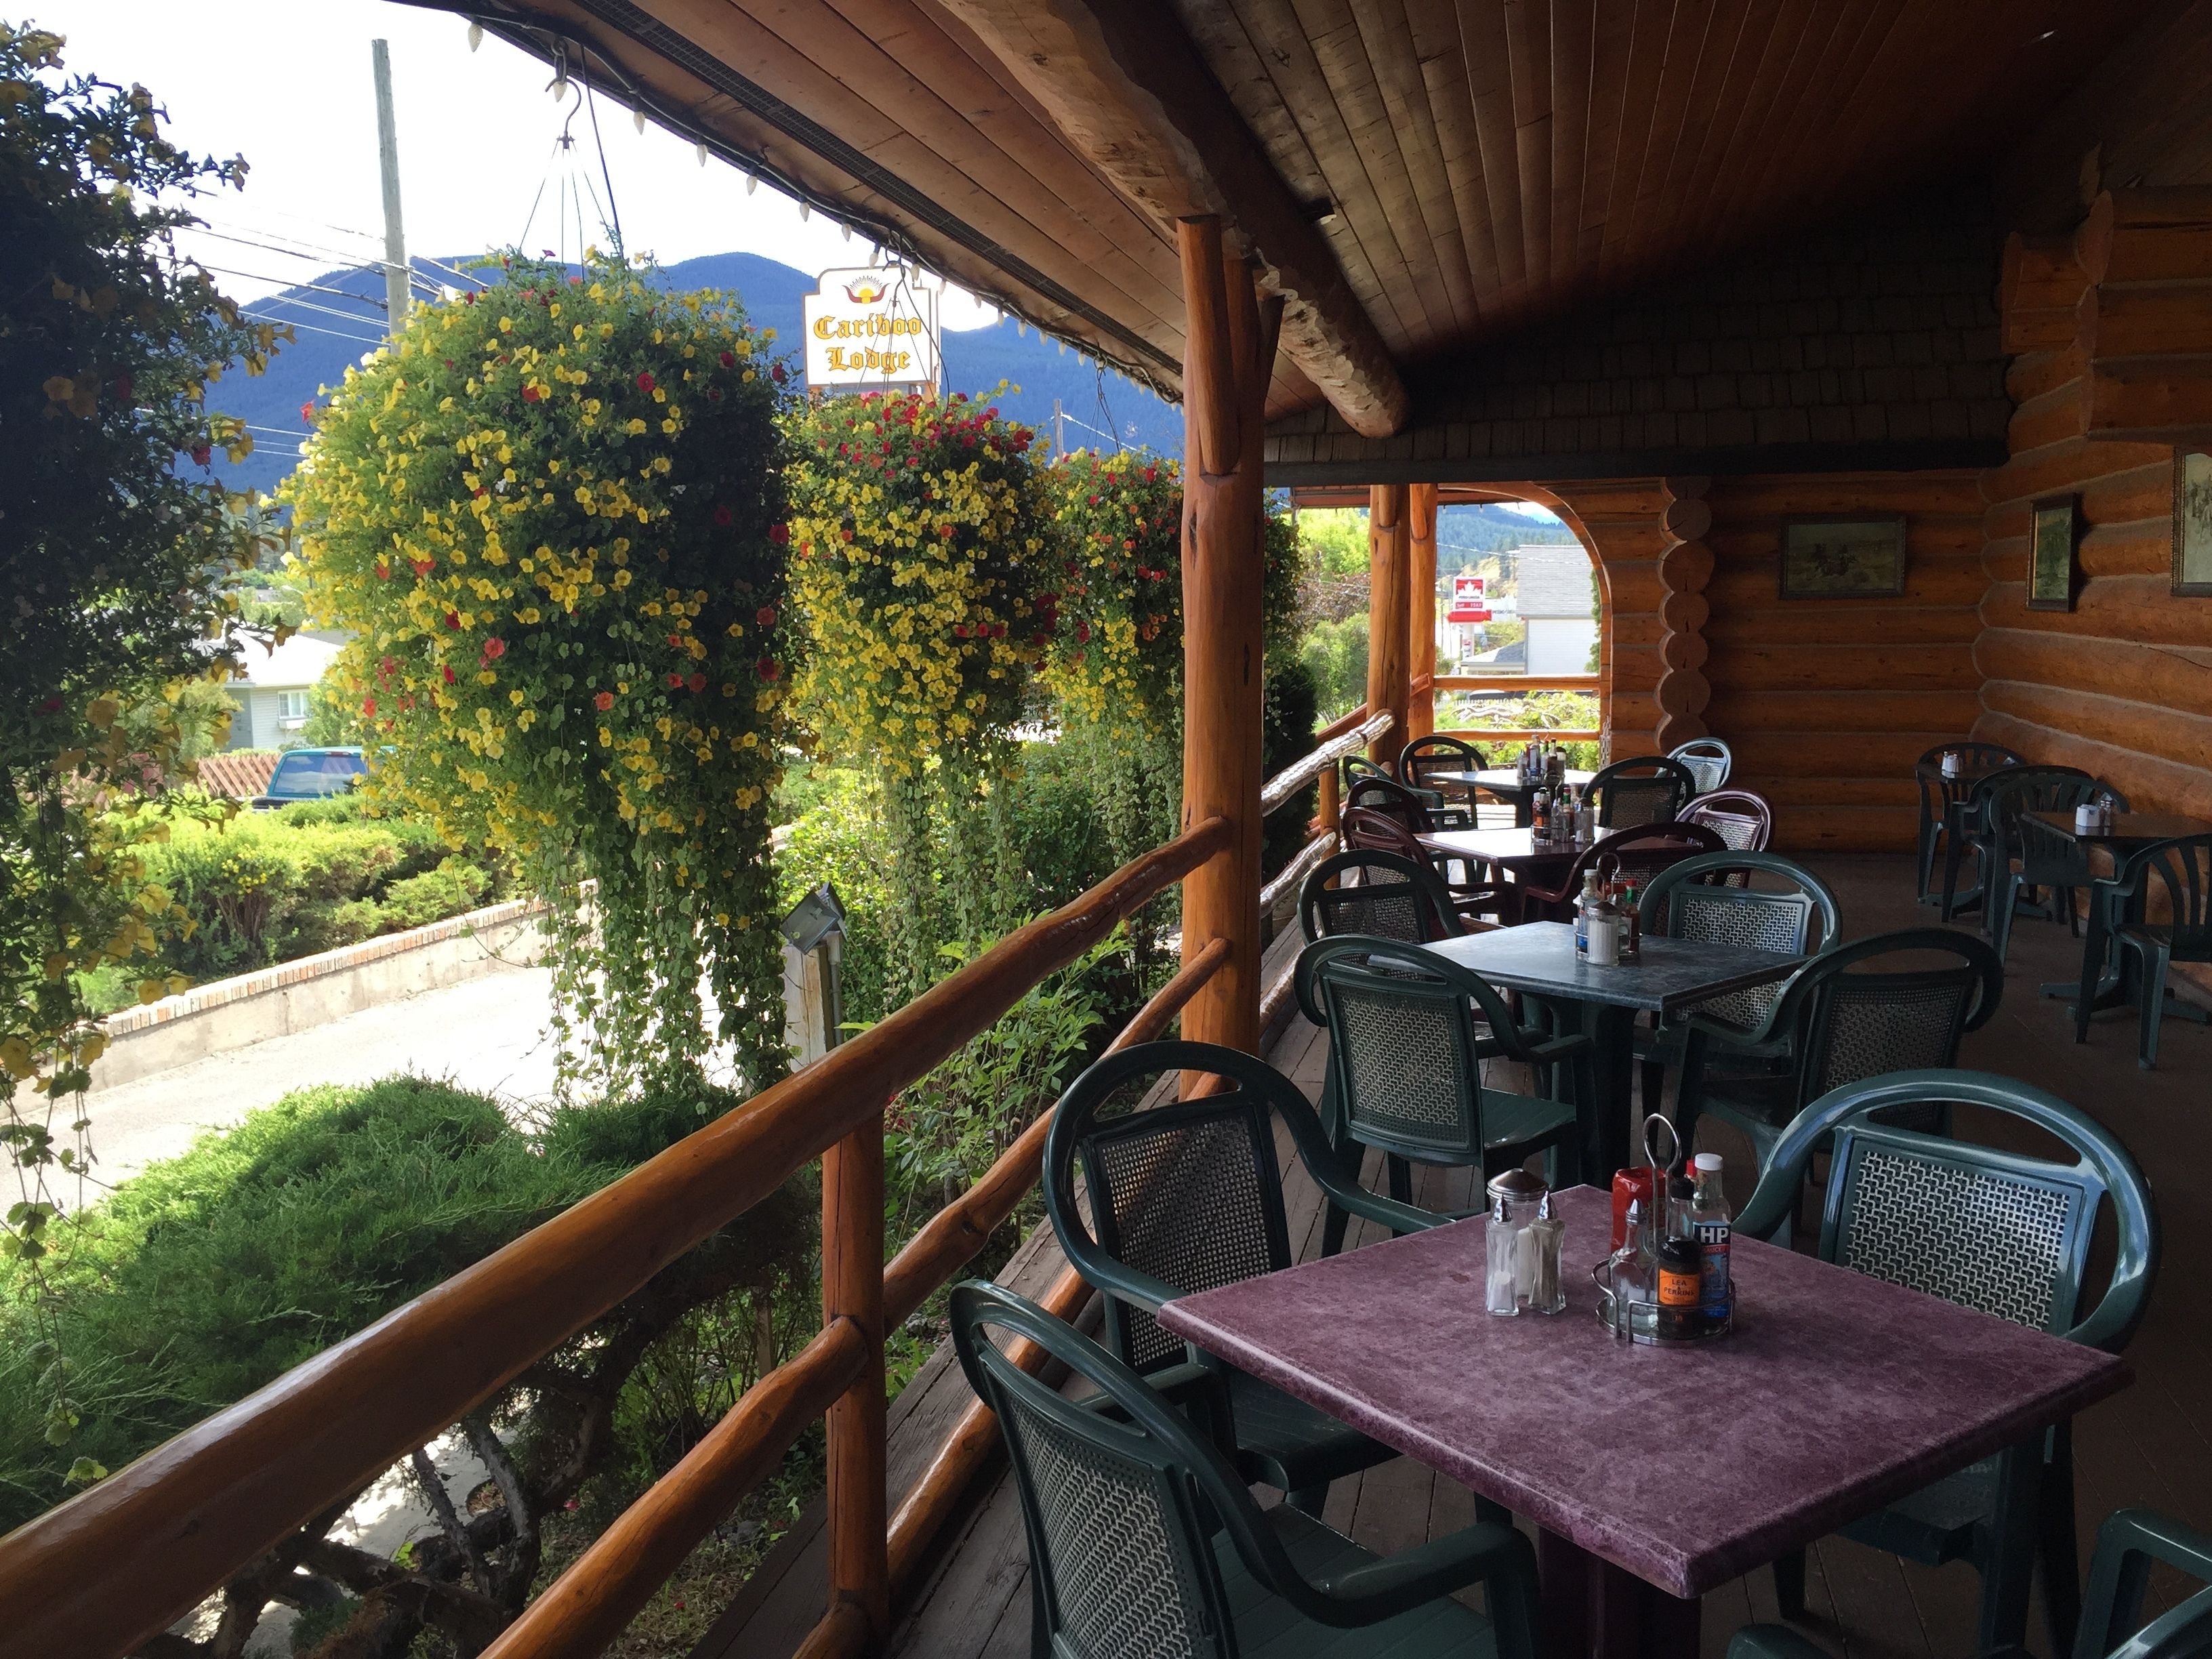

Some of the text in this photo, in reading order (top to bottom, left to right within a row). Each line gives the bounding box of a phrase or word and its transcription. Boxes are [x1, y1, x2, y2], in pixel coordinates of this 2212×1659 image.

[814, 313, 921, 339] Cariboo
[825, 346, 910, 374] Lodge
[1700, 1227, 1729, 1244] HP
